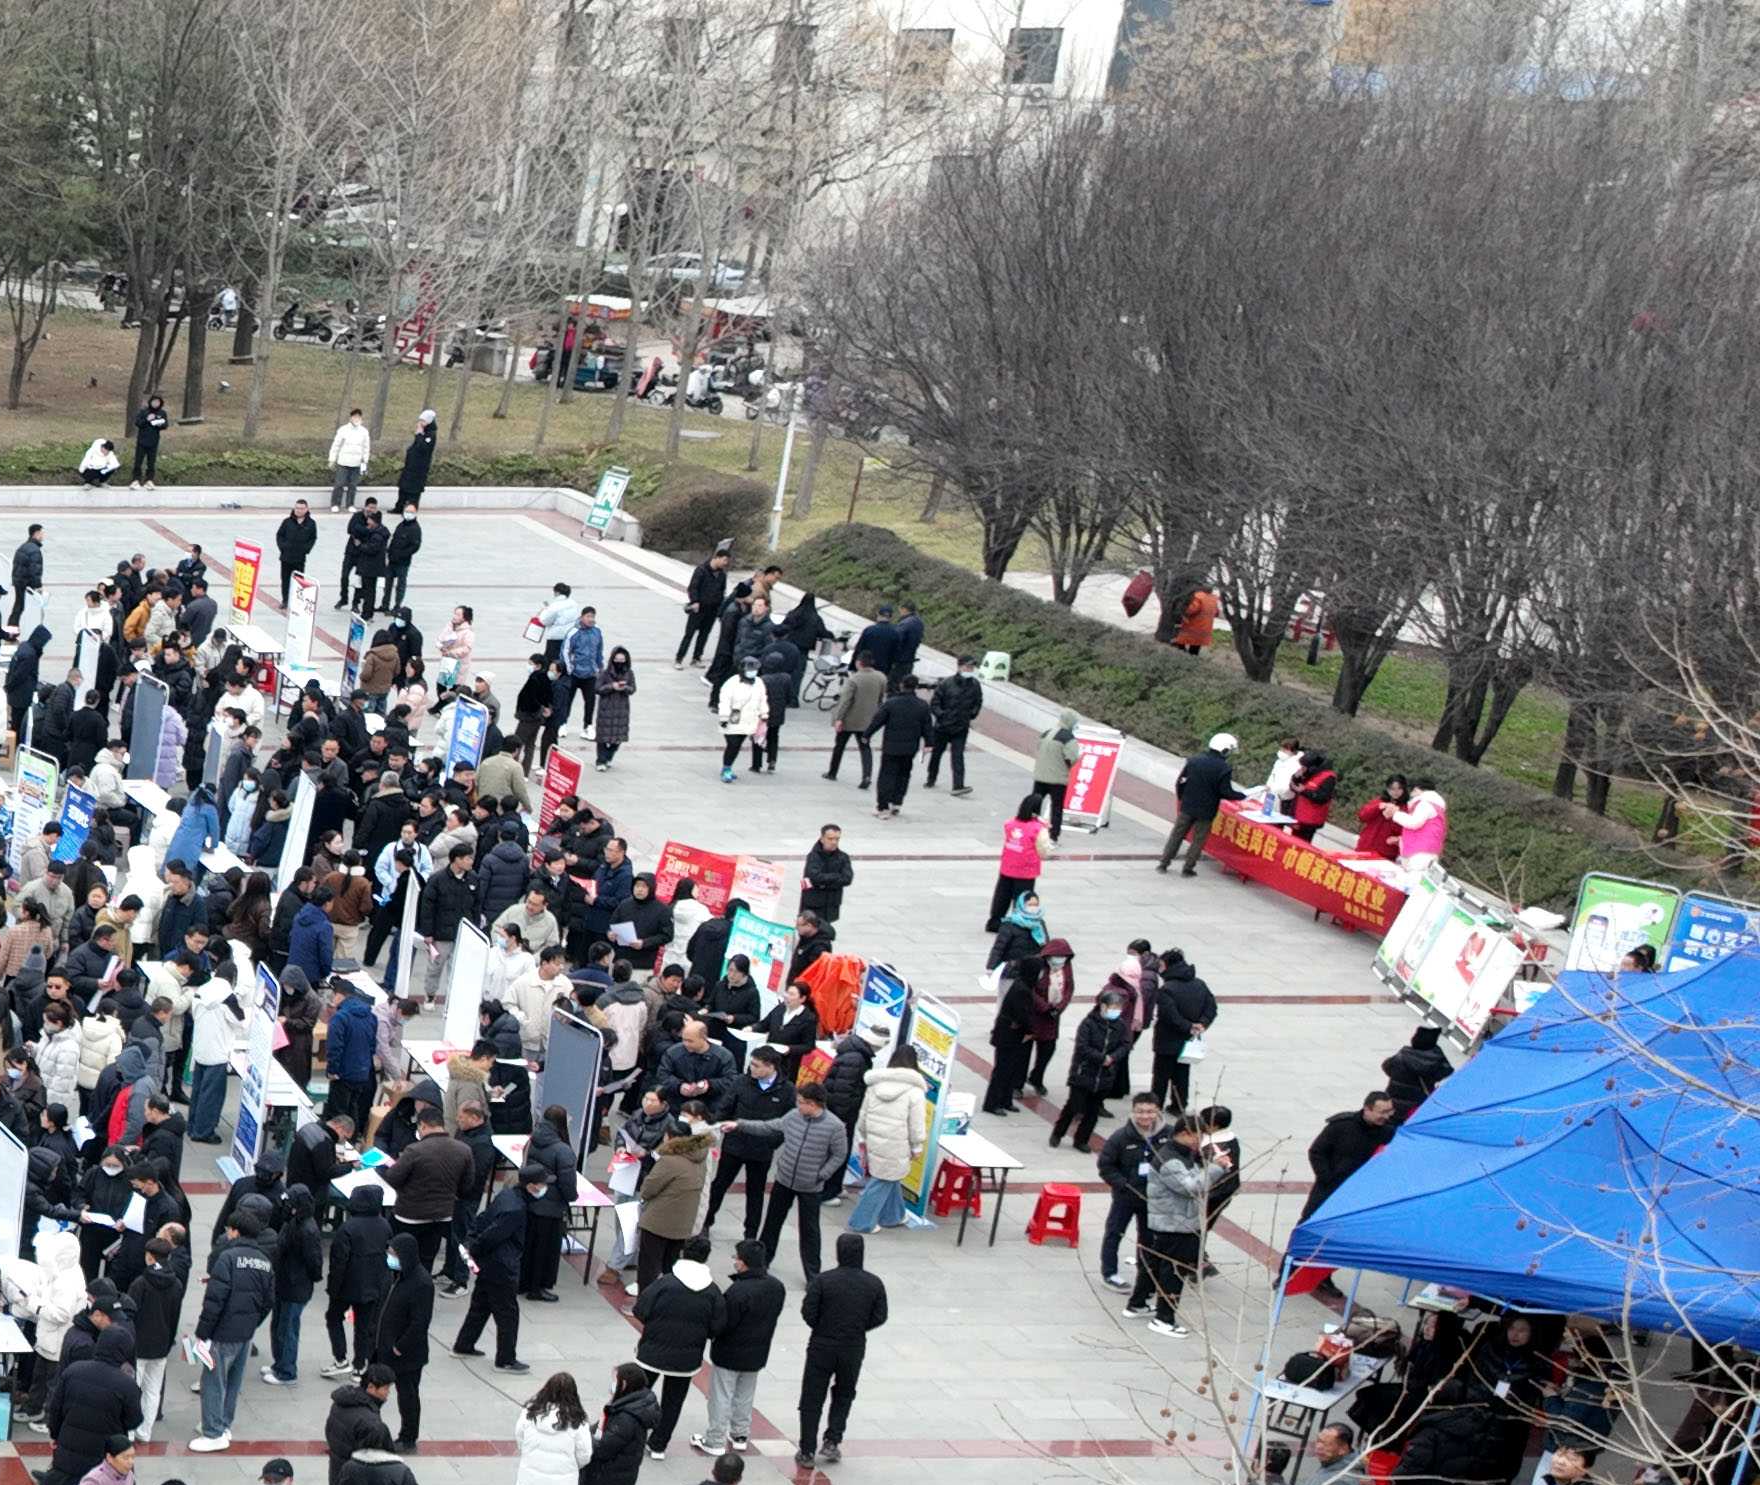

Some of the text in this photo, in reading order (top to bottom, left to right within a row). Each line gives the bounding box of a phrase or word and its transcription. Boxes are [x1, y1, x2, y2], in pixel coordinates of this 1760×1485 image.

[1211, 812, 1388, 913] 春风送岗位 巾帼家政助就业
